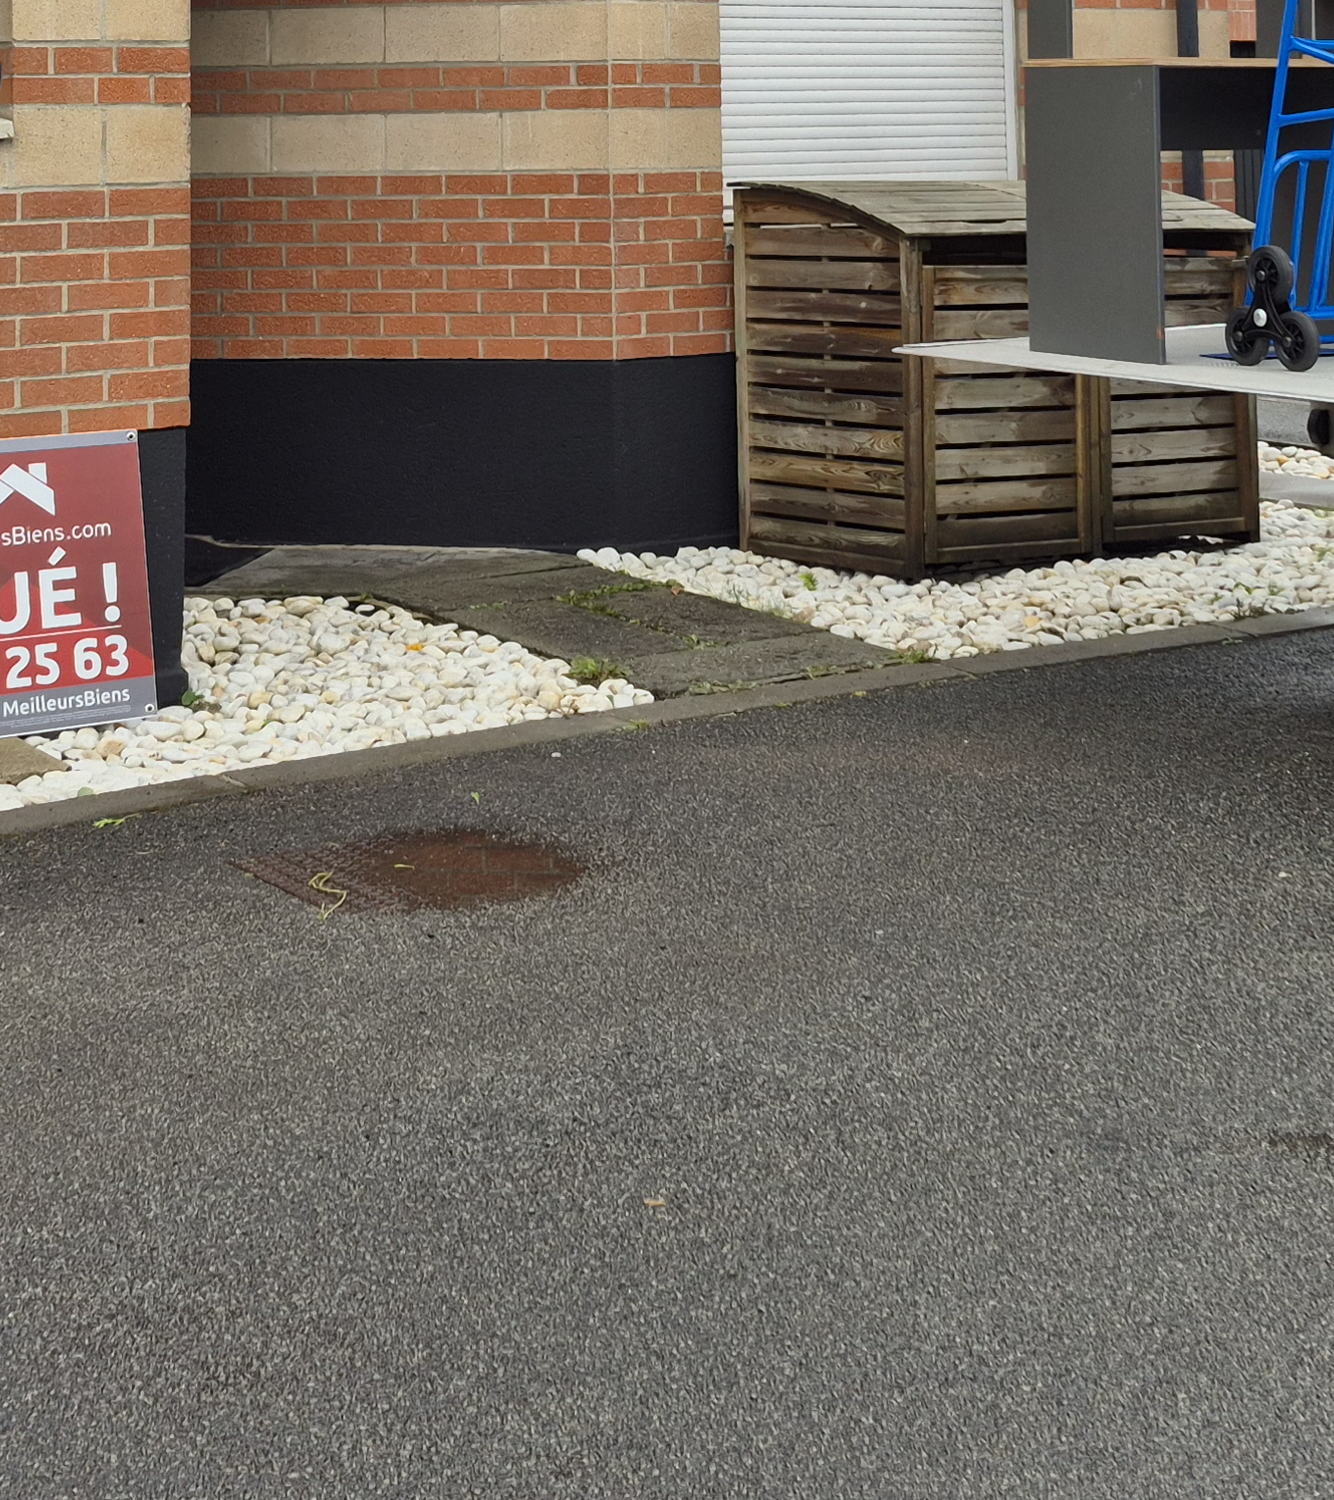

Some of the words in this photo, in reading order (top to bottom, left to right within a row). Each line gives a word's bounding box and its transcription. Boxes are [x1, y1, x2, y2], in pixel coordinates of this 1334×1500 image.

[5, 642, 61, 689] 25
[73, 635, 130, 680] 63
[3, 687, 130, 717] MeilleursBiens
